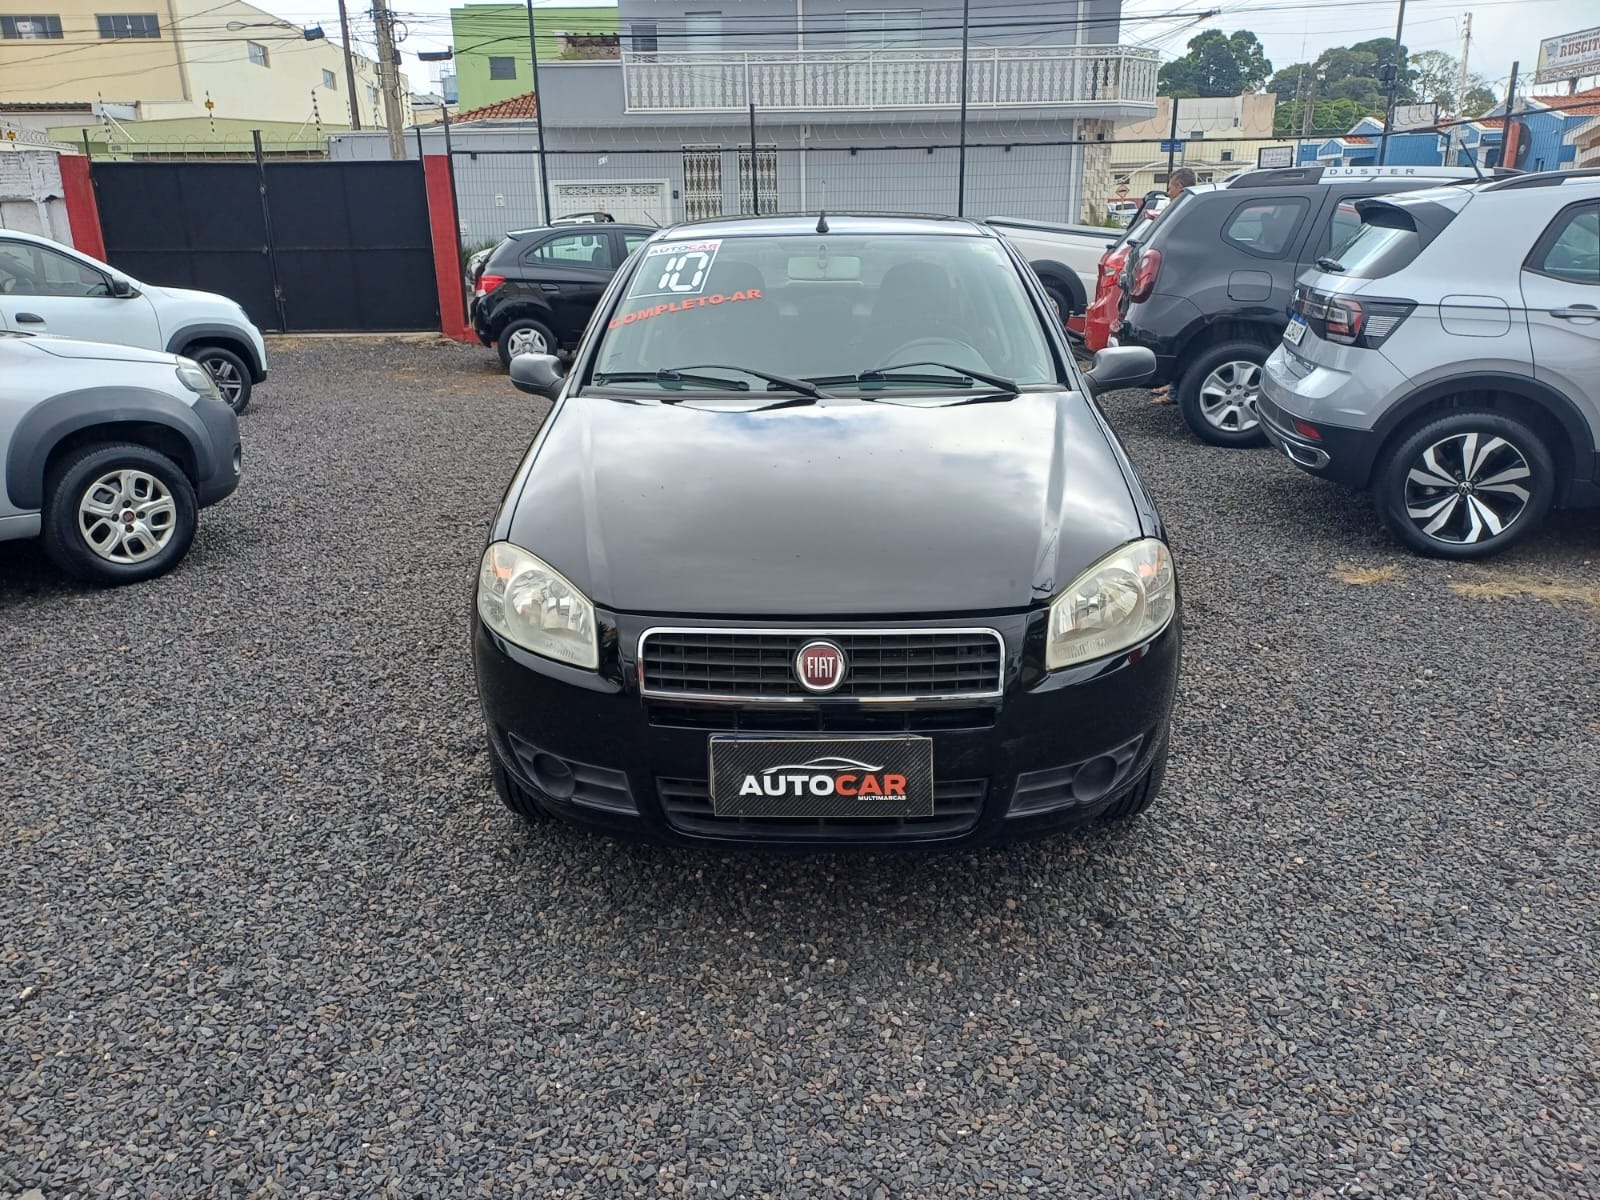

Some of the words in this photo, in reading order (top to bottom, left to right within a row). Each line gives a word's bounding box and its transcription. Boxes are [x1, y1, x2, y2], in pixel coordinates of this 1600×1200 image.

[1560, 38, 1600, 57] RUSCIT
[650, 243, 718, 254] AUTOCAR
[658, 252, 709, 291] 10
[608, 289, 762, 329] COMPLETO-AR
[807, 656, 835, 678] FIAT
[739, 774, 907, 796] AUTOCAR
